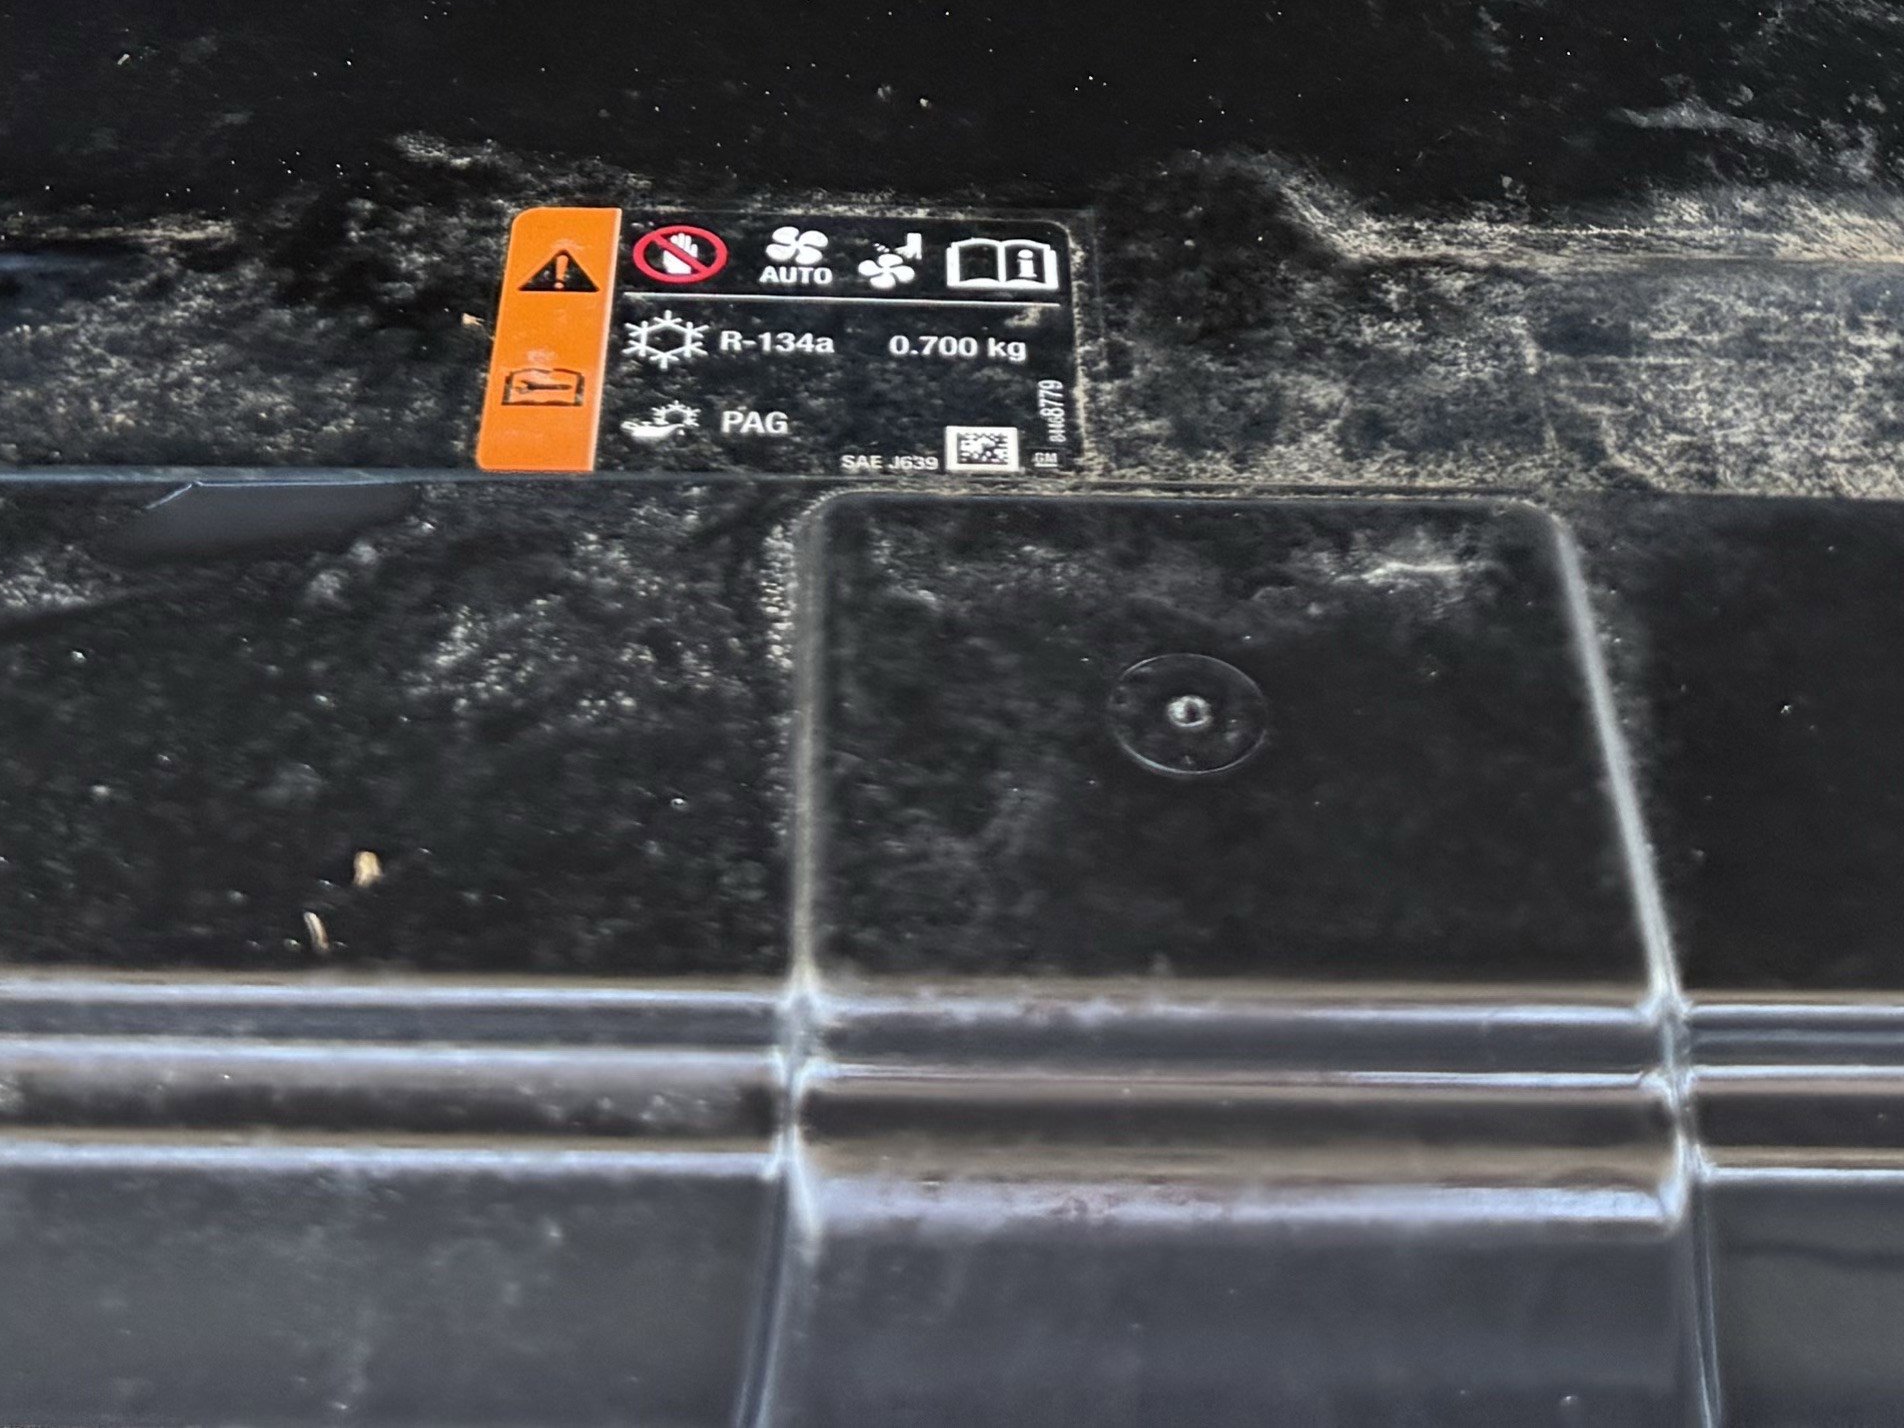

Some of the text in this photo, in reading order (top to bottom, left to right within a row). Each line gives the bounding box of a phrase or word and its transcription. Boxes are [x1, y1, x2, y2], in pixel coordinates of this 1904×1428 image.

[759, 265, 833, 286] AUTO
[720, 331, 1027, 362] R-134a 0.700 kg
[721, 410, 790, 434] PAG
[841, 454, 939, 472] SAE J639
